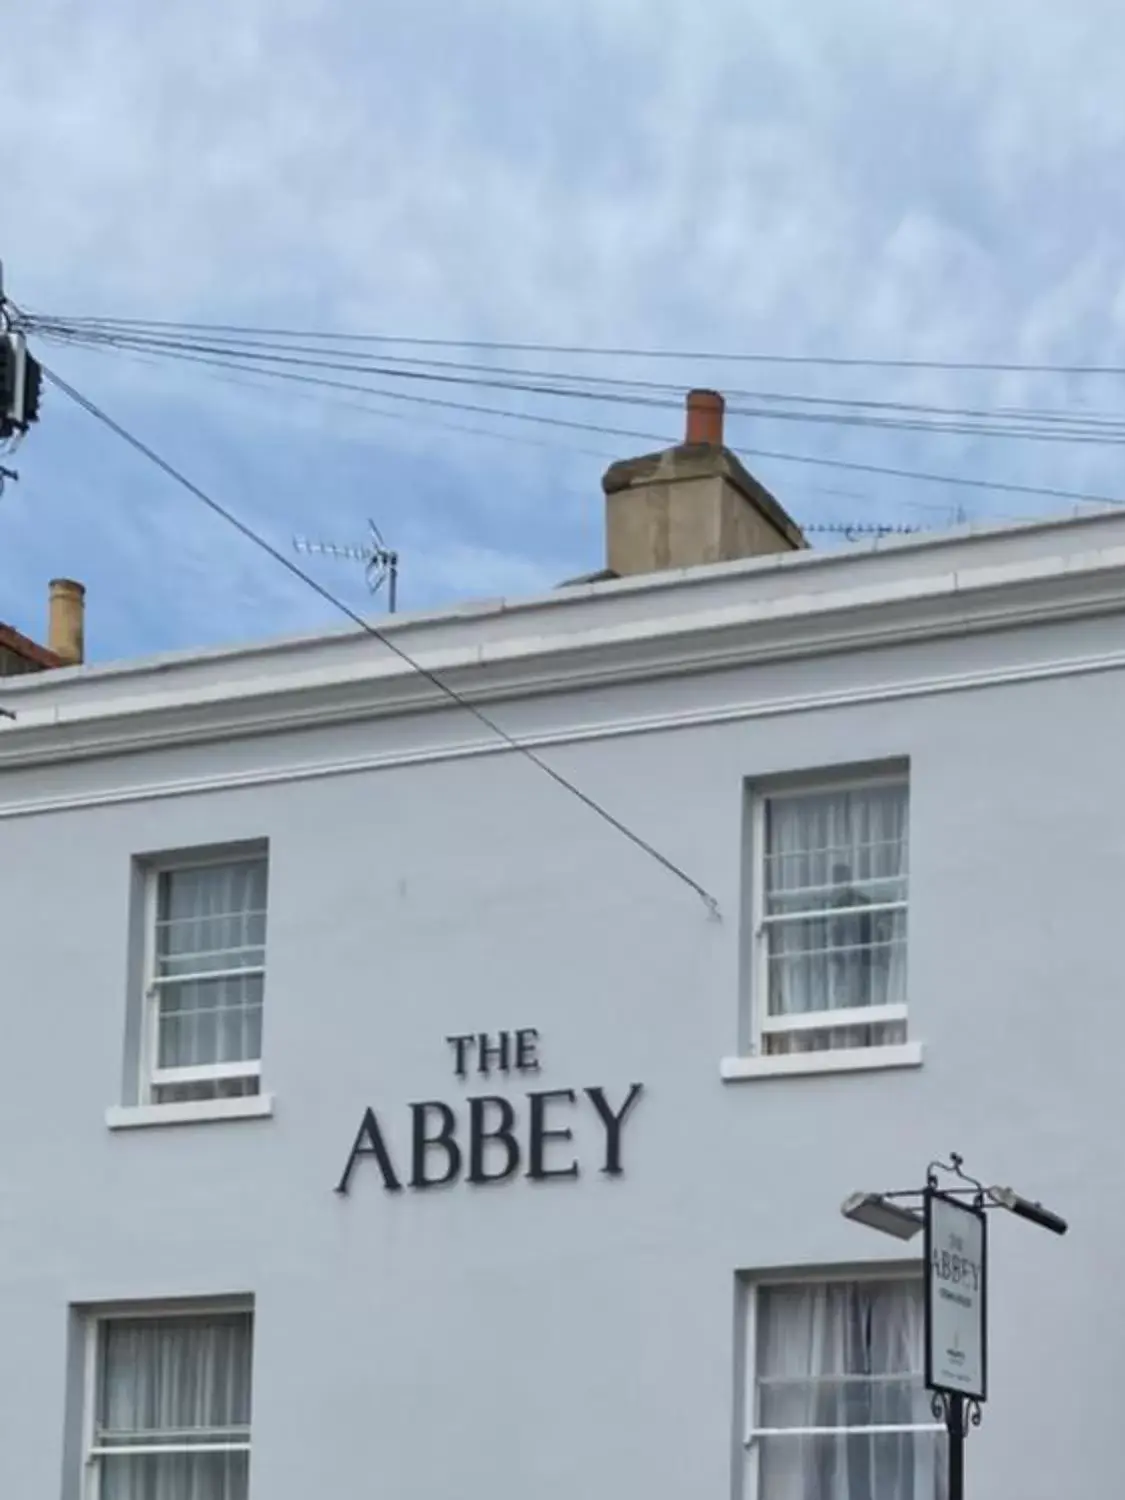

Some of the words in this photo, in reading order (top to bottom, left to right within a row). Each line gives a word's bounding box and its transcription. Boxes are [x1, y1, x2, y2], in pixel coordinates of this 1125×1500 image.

[446, 1028, 540, 1075] THE
[334, 1083, 644, 1194] ABBEY
[932, 1247, 980, 1292] ABBEY
